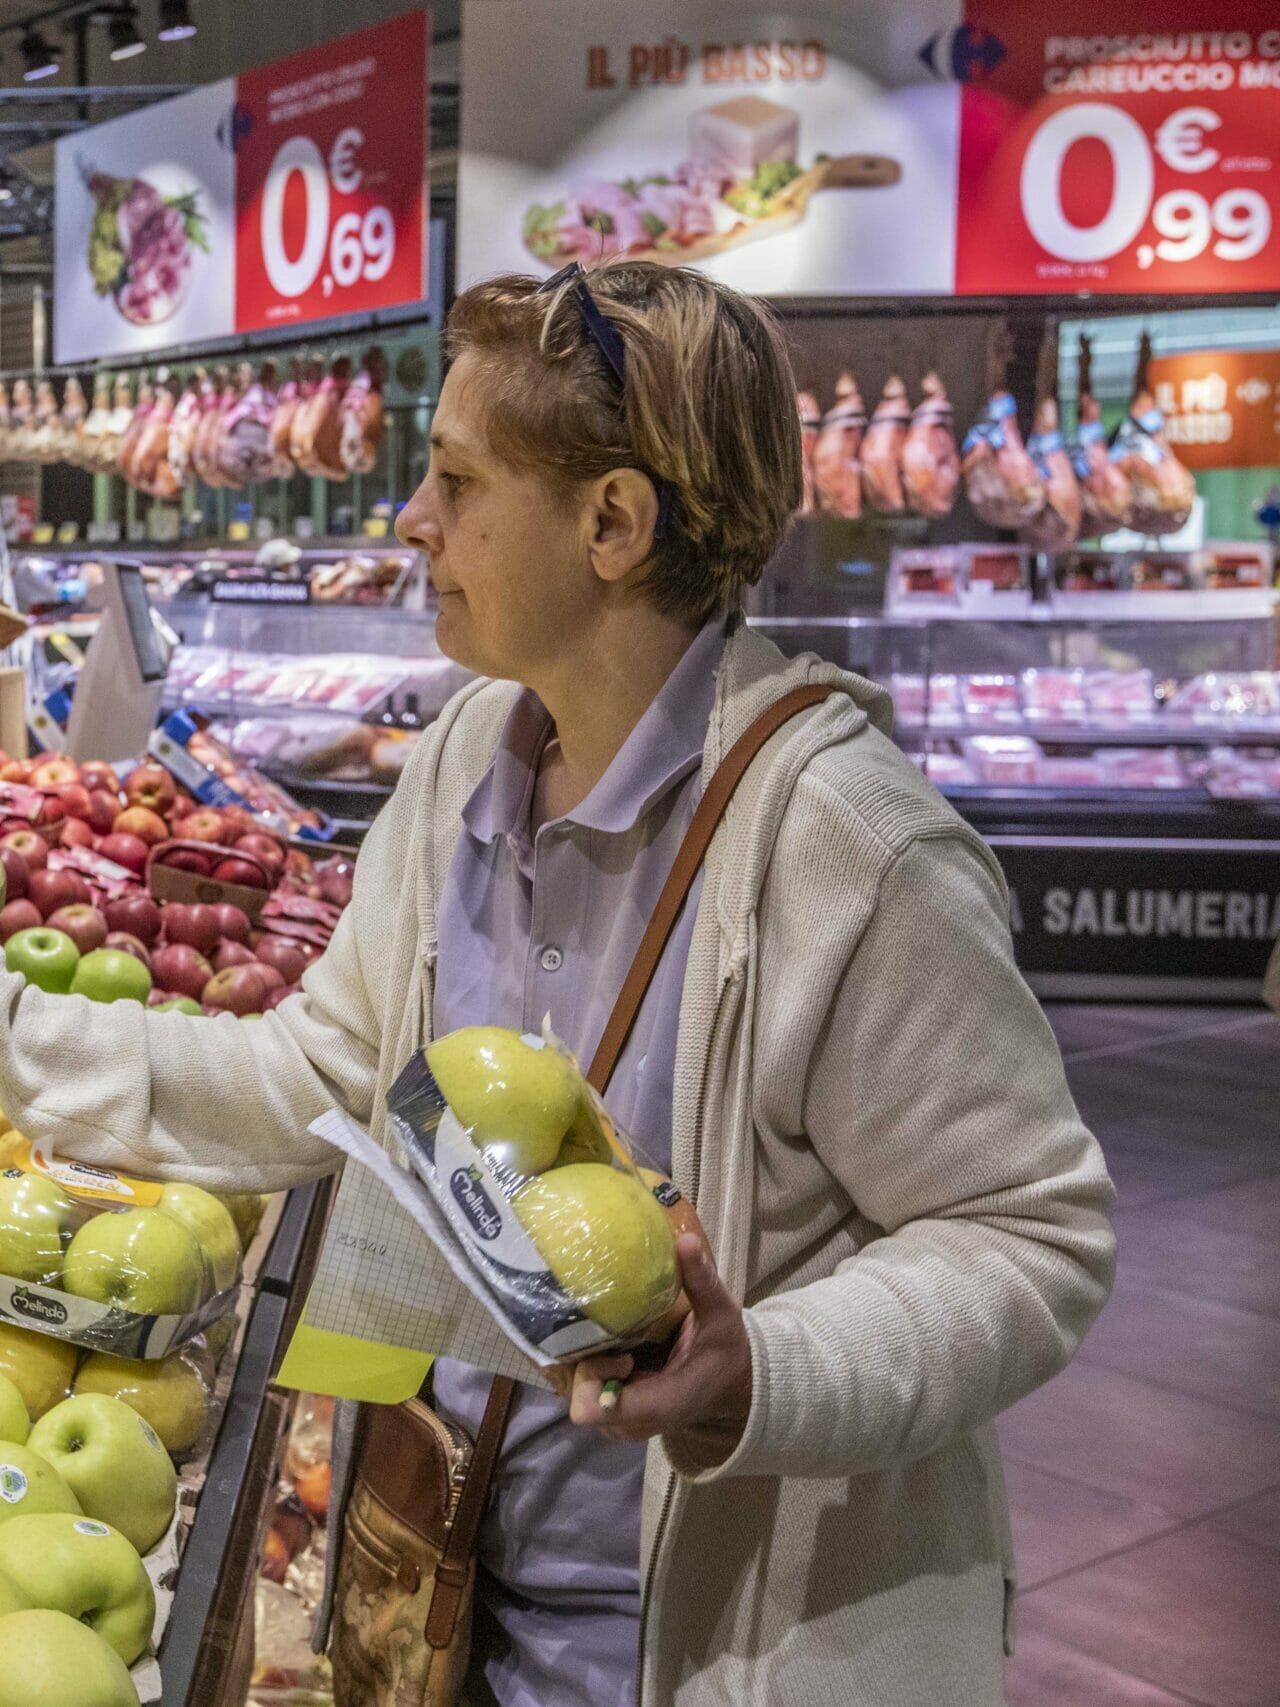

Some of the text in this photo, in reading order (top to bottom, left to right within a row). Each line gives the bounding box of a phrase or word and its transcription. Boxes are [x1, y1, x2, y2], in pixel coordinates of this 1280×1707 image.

[703, 39, 825, 82] BASSO
[1239, 60, 1280, 89] M
[454, 1170, 501, 1239] Melinda
[13, 1296, 66, 1319] Melinda
